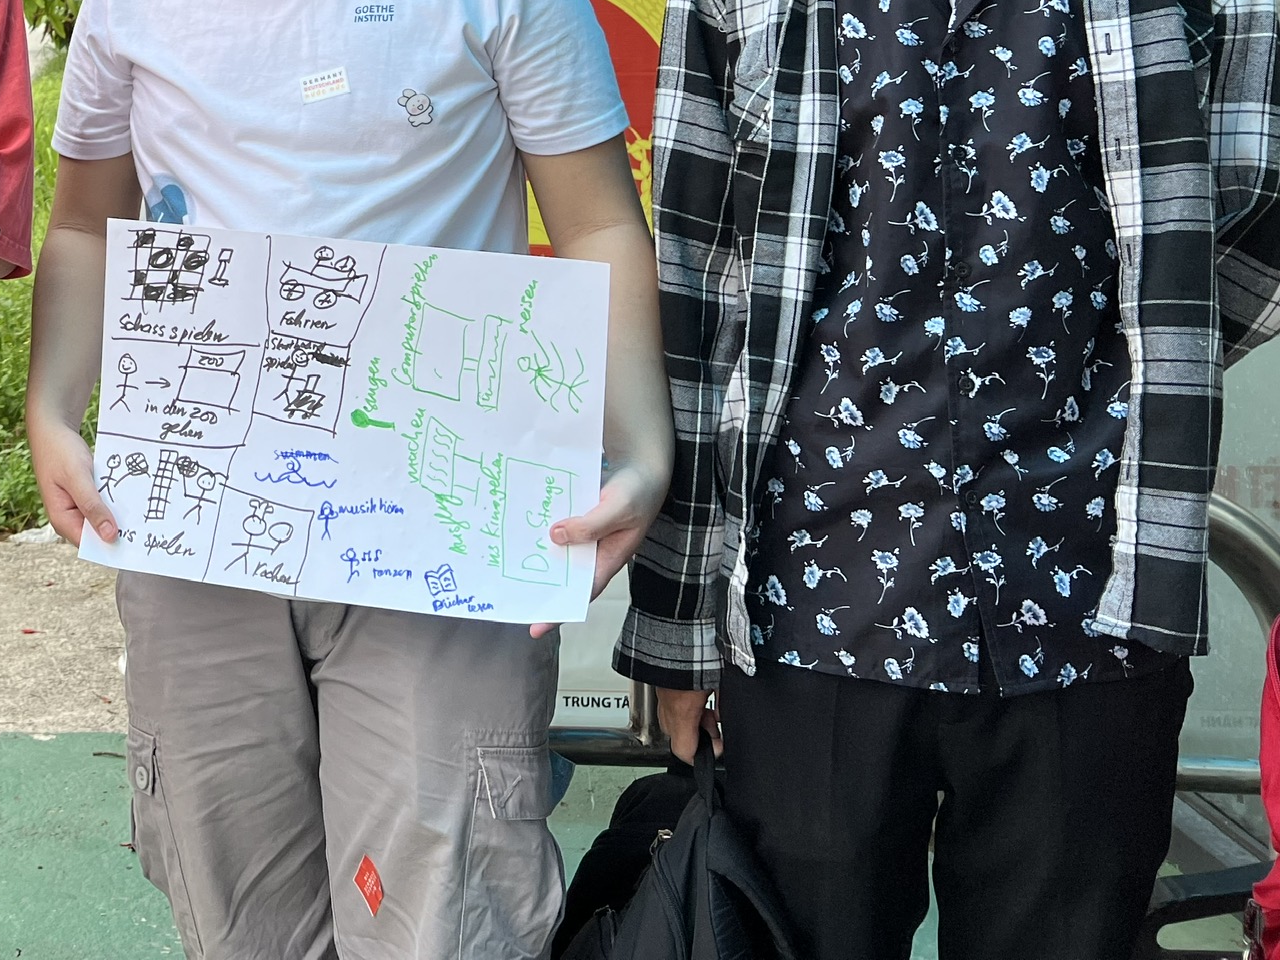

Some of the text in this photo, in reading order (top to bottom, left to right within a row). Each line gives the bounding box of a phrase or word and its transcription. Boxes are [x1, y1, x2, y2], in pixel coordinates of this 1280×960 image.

[354, 4, 395, 15] GOETHE
[353, 13, 395, 23] INSTITUT
[302, 70, 343, 86] GERMANY
[562, 696, 611, 708] TRUNG
